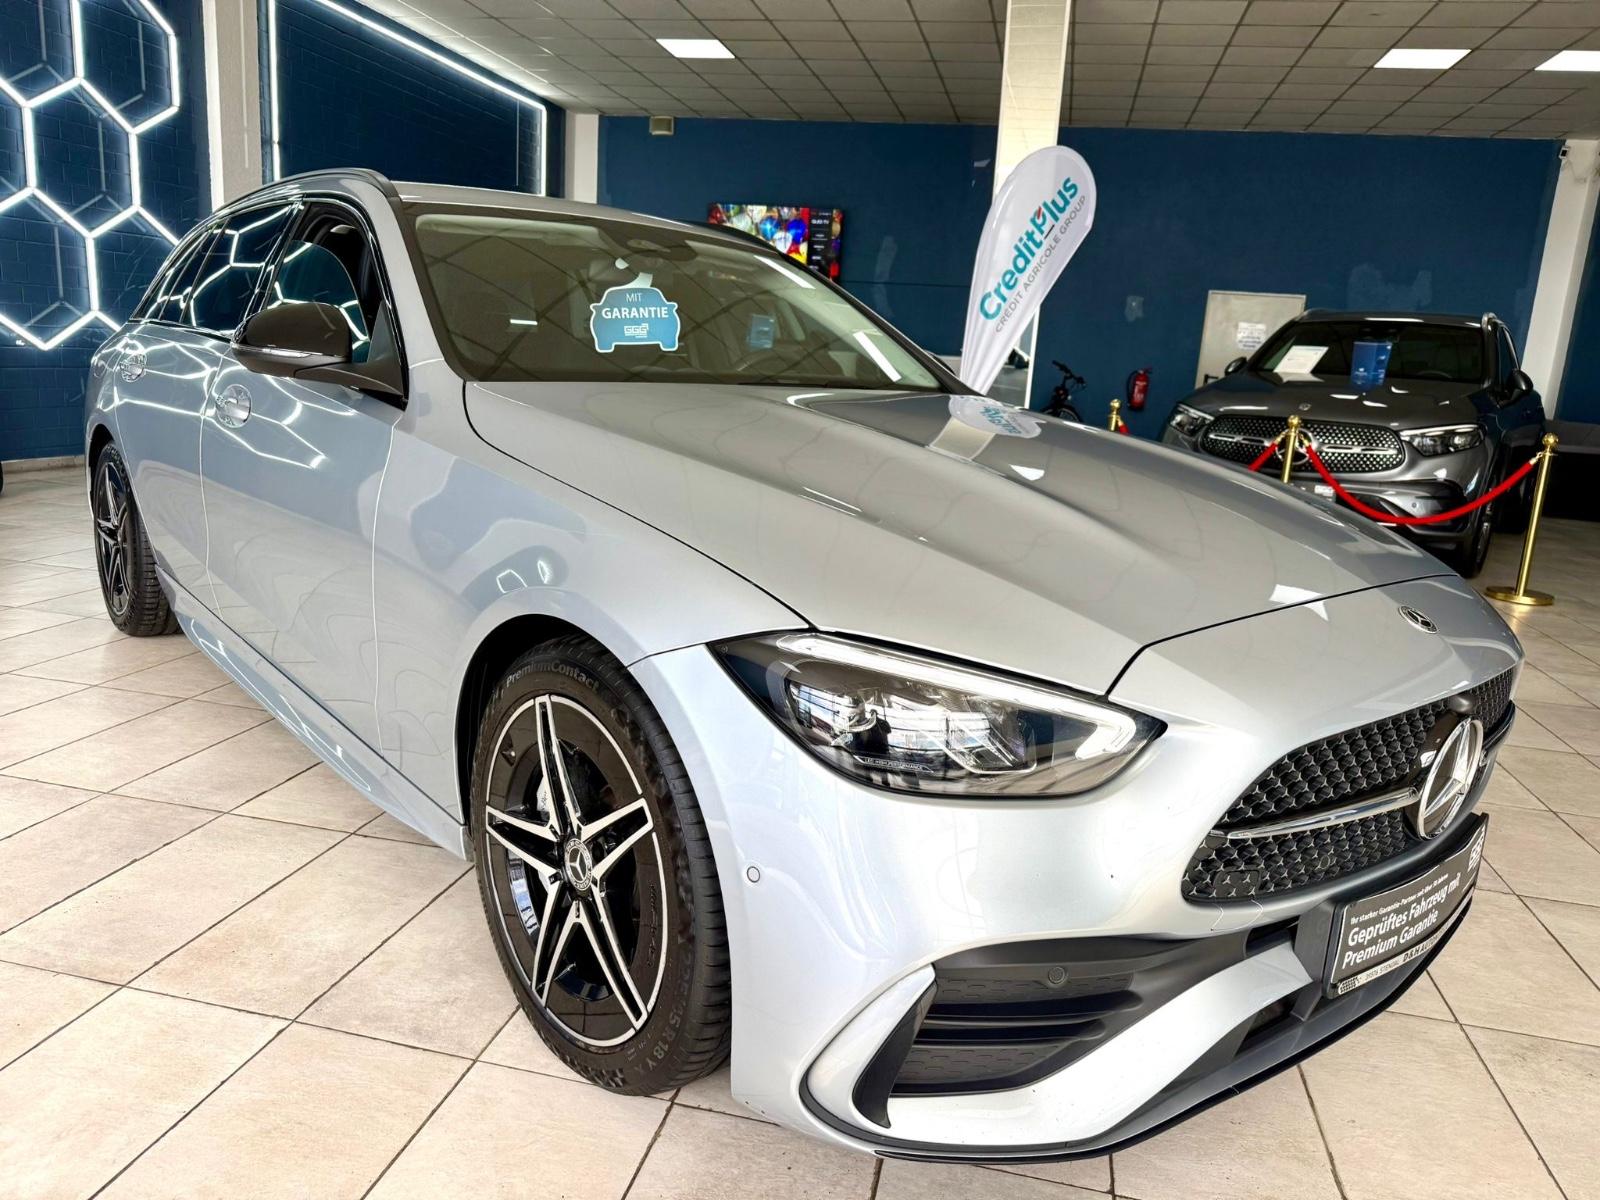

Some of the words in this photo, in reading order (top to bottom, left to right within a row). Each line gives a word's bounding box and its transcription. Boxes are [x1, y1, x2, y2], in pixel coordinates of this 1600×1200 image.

[979, 175, 1079, 321] CreditPlus
[1023, 235, 1062, 290] AGRICOLE
[1059, 194, 1087, 236] GROUP
[601, 306, 669, 319] GARANTIE
[625, 292, 642, 303] MIT
[506, 659, 601, 693] PremiumContact
[1342, 934, 1398, 970] Premium
[1399, 908, 1439, 944] Garantie
[1348, 910, 1408, 947] Geprüftes
[1408, 885, 1449, 921] Fahrzeug
[1448, 872, 1462, 894] mit
